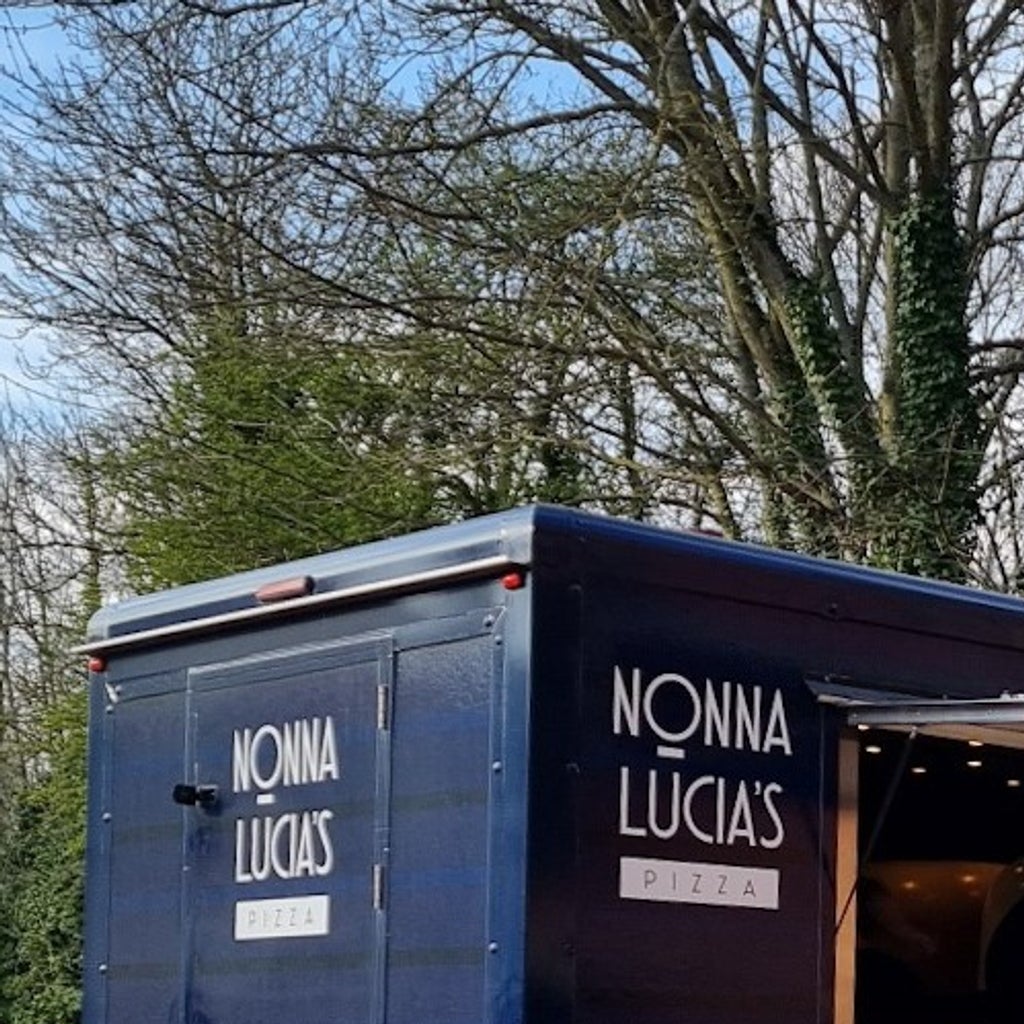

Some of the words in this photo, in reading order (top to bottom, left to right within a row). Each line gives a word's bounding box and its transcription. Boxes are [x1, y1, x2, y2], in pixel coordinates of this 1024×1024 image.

[612, 664, 793, 757] NONNA
[233, 716, 340, 796] NONNA
[619, 766, 785, 849] LUCIA'S
[235, 810, 335, 882] LUCIA'S
[643, 869, 757, 898] PIZZA
[248, 905, 314, 929] PIZZA
